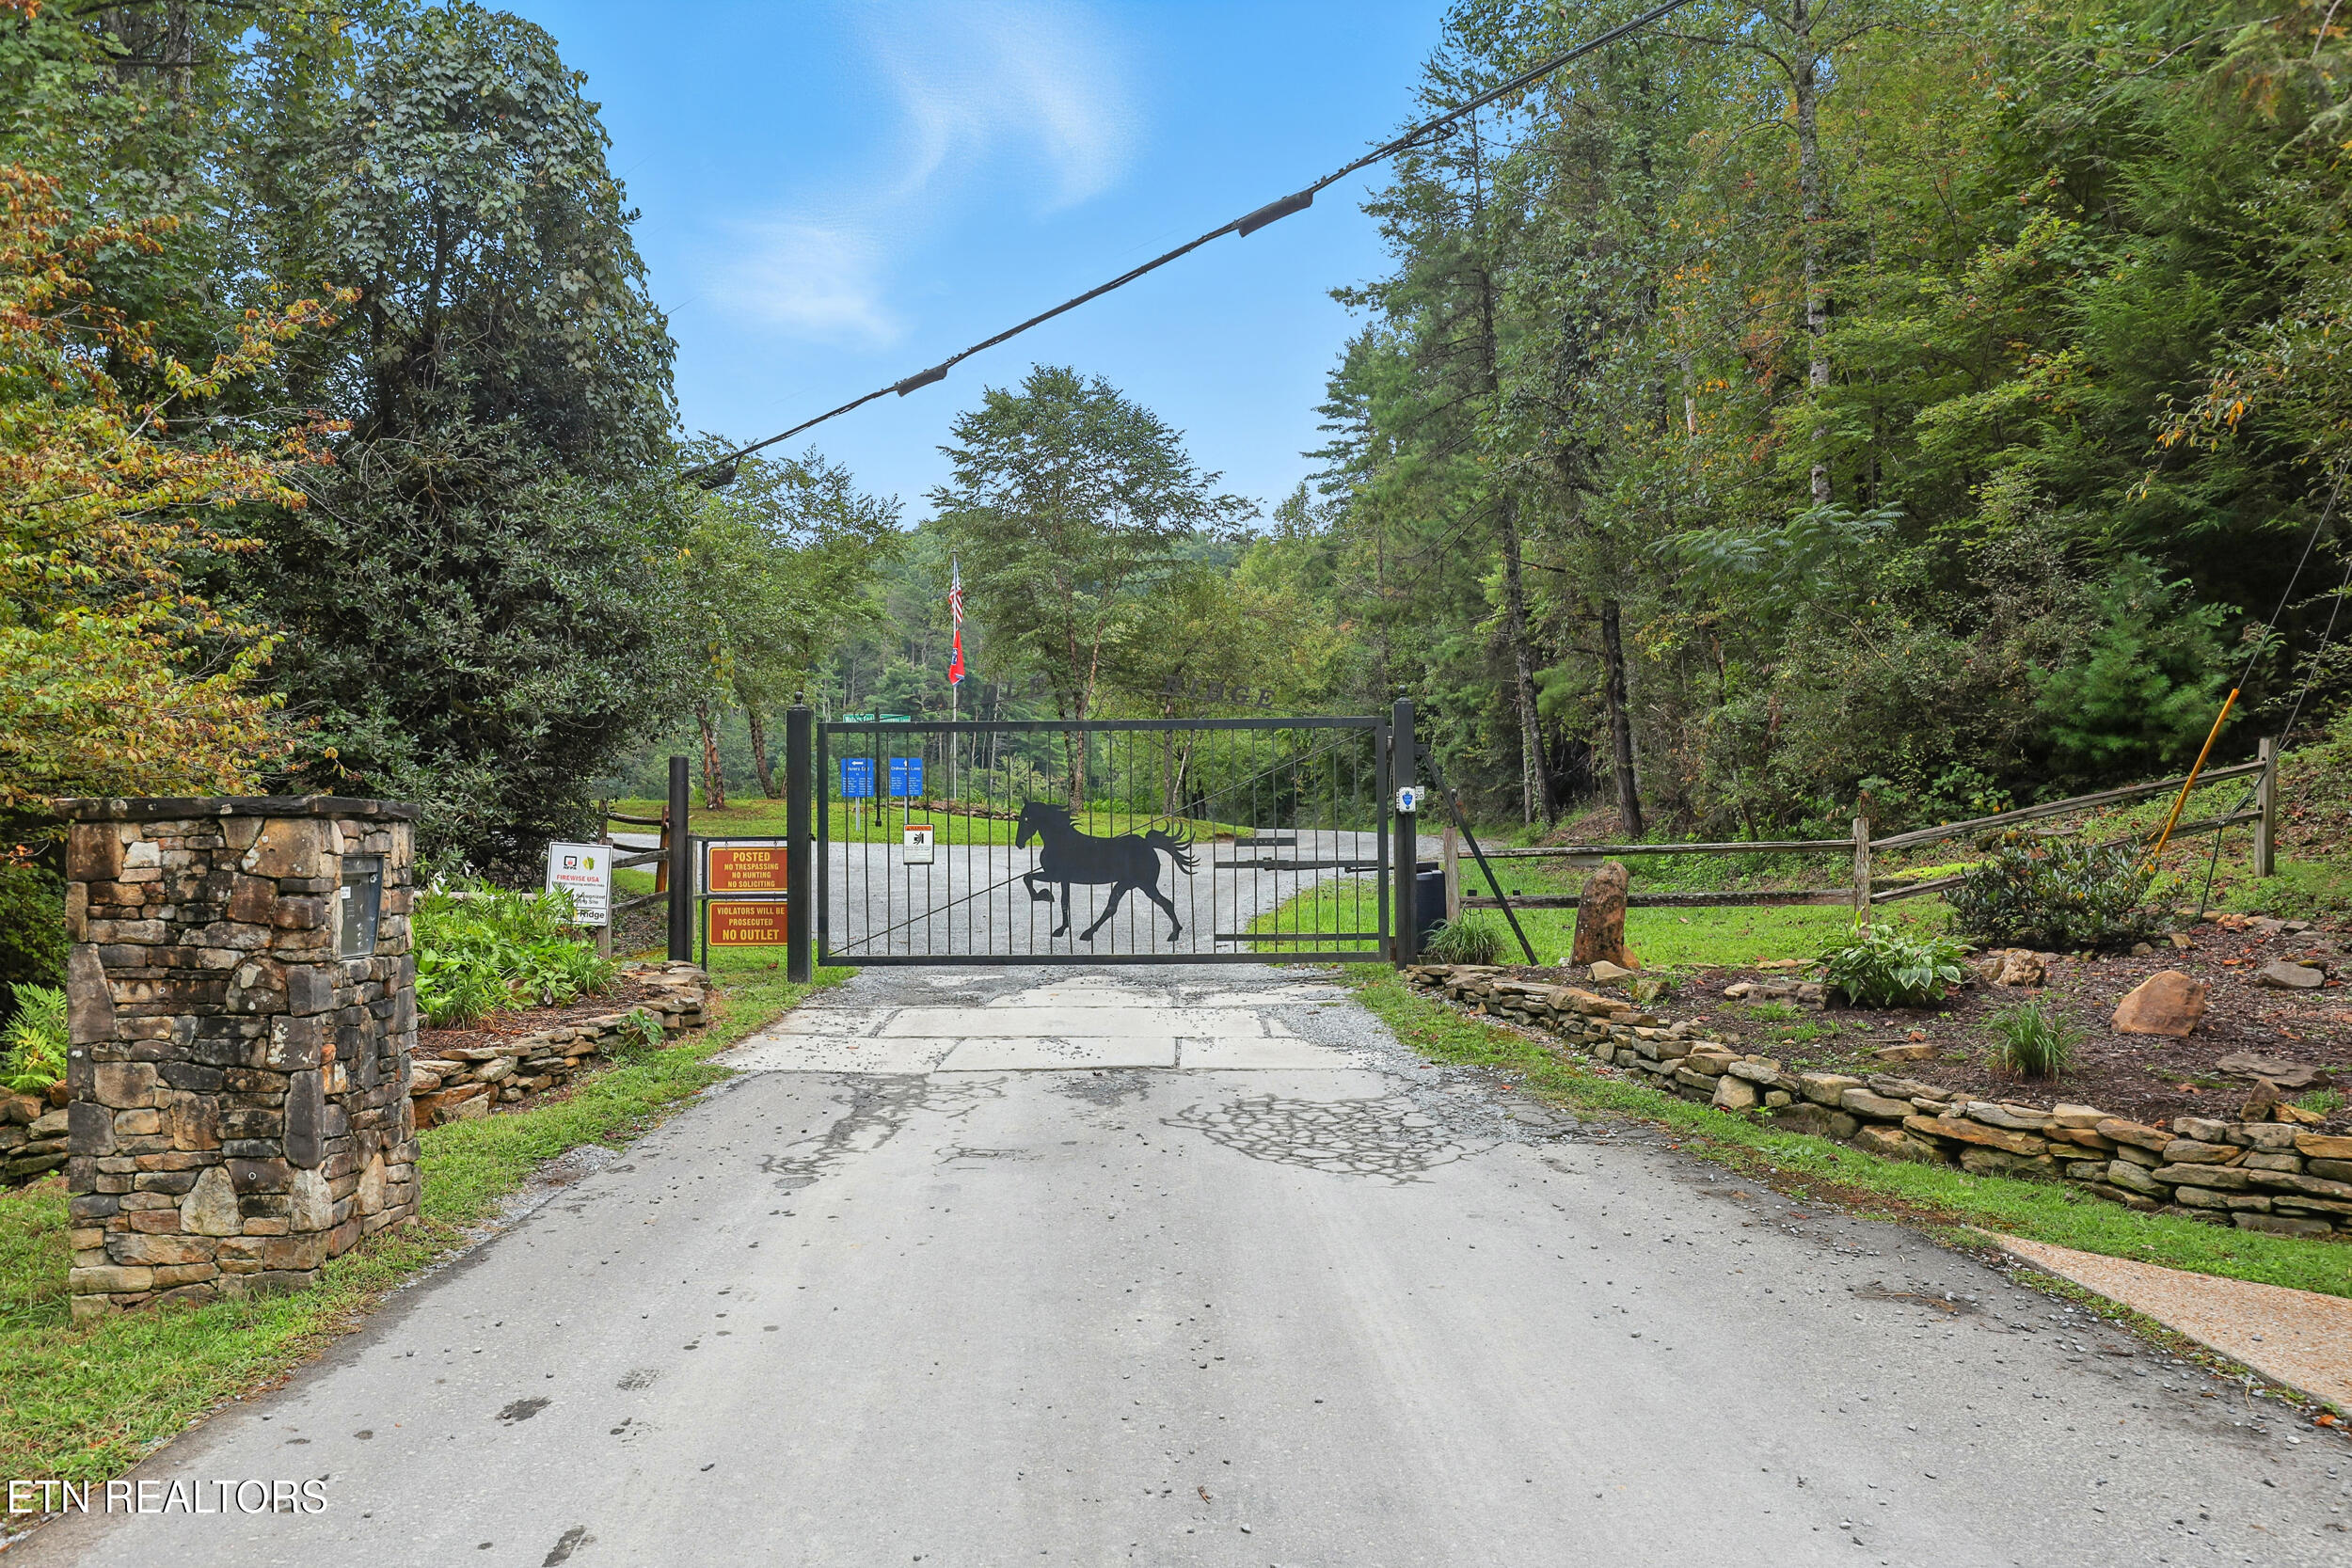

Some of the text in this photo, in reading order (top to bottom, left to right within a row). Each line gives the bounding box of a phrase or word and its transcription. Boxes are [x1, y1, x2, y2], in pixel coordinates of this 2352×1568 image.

[733, 851, 771, 862] POSTED
[580, 910, 605, 920] Ridge
[717, 907, 755, 915] VIOLATORS
[723, 929, 779, 941] NO OUTLET
